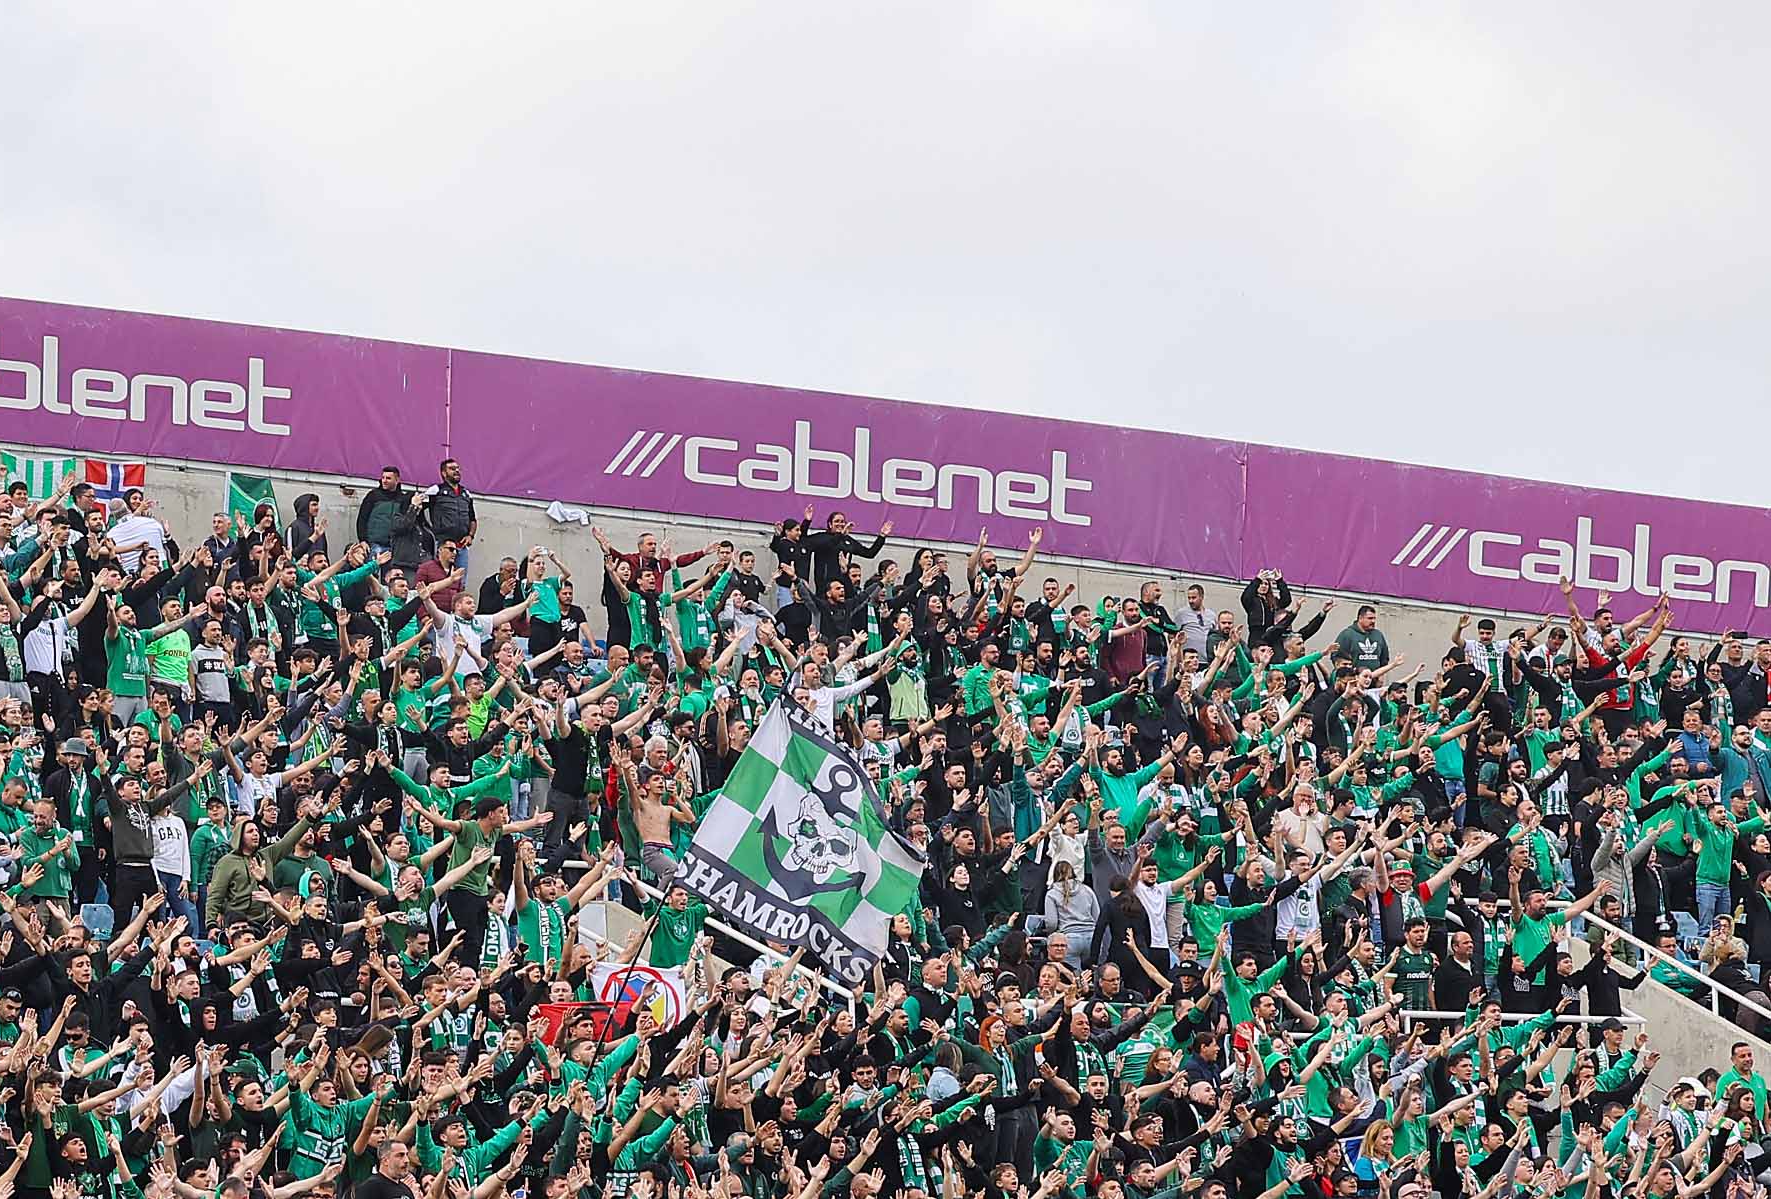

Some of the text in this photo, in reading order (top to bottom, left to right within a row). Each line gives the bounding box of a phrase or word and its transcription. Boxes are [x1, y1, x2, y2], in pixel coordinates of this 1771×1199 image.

[684, 420, 1092, 526] cablenet
[158, 827, 182, 841] GAP
[674, 852, 872, 984] SHAMROCKS
